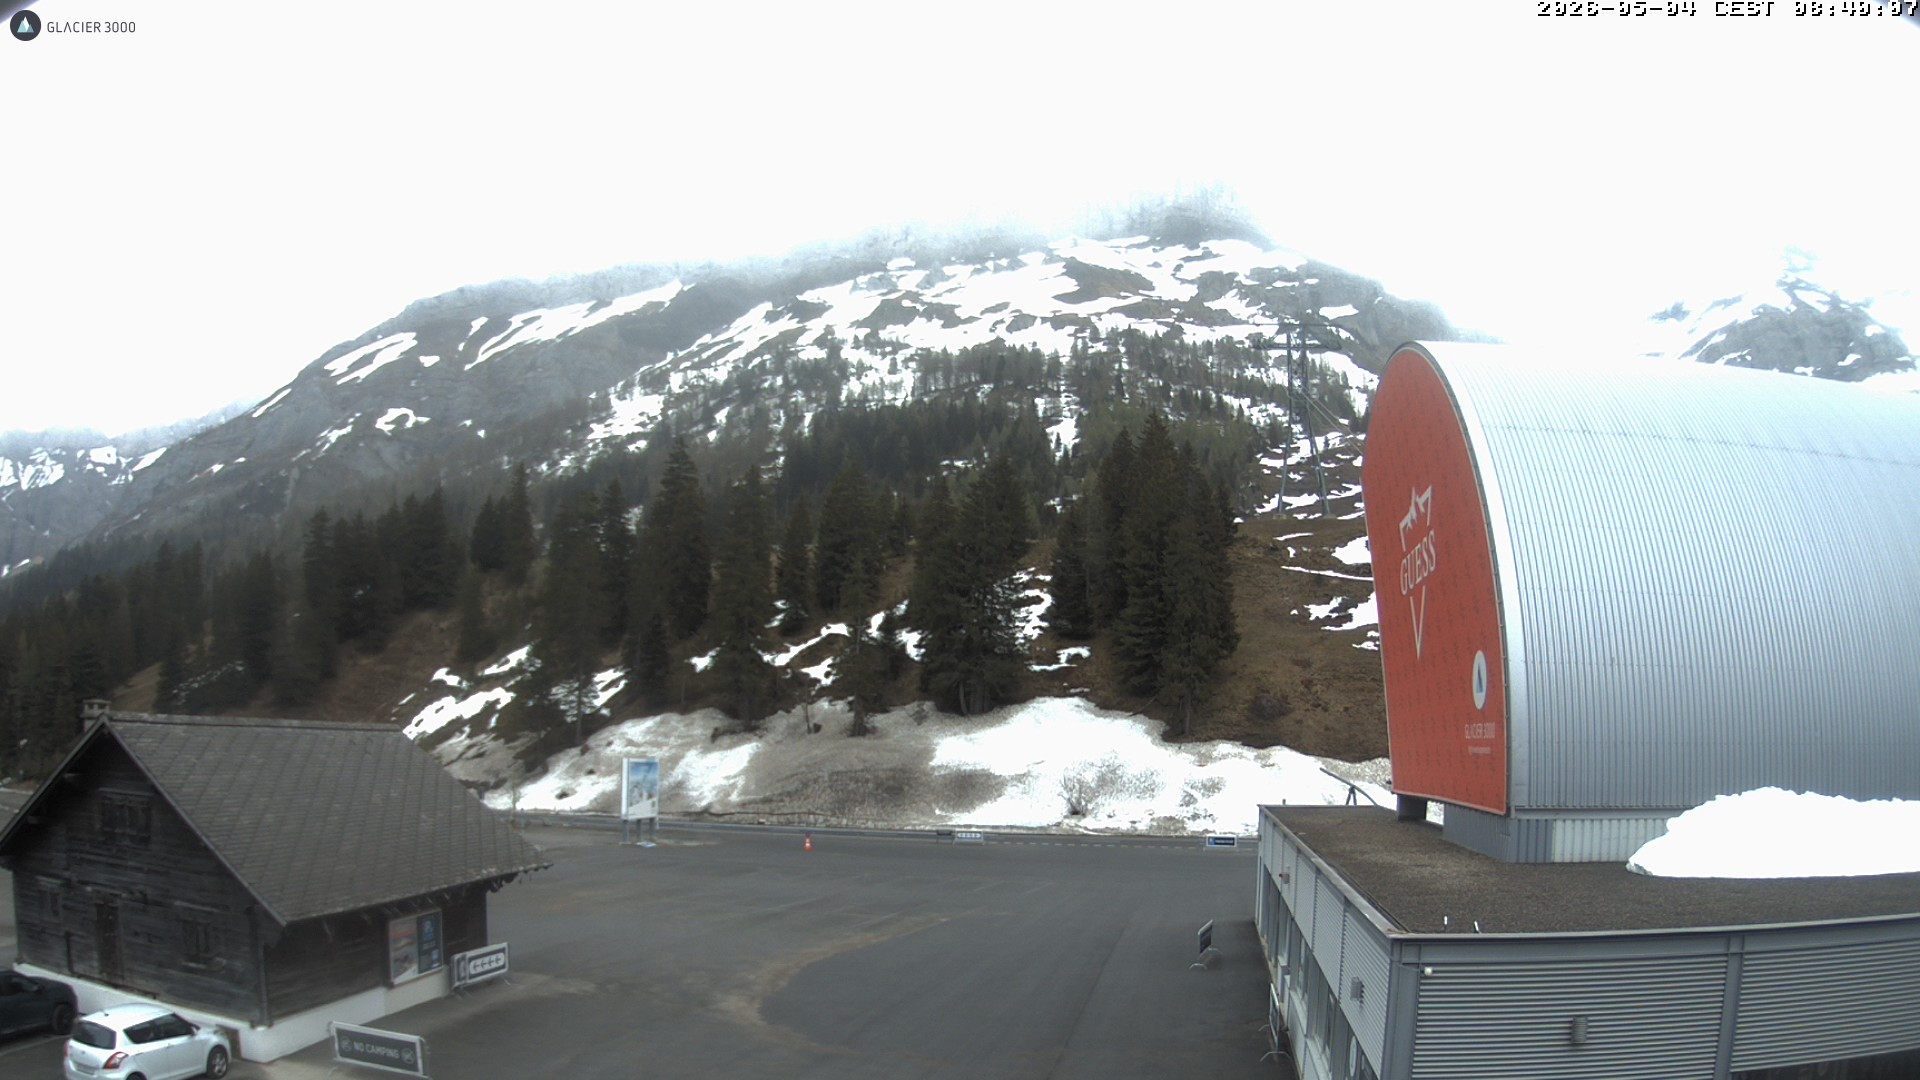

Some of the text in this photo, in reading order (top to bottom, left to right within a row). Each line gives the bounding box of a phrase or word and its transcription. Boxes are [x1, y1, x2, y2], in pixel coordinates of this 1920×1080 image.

[1400, 529, 1436, 595] GUESS
[353, 1041, 400, 1059] NO CAMPING
